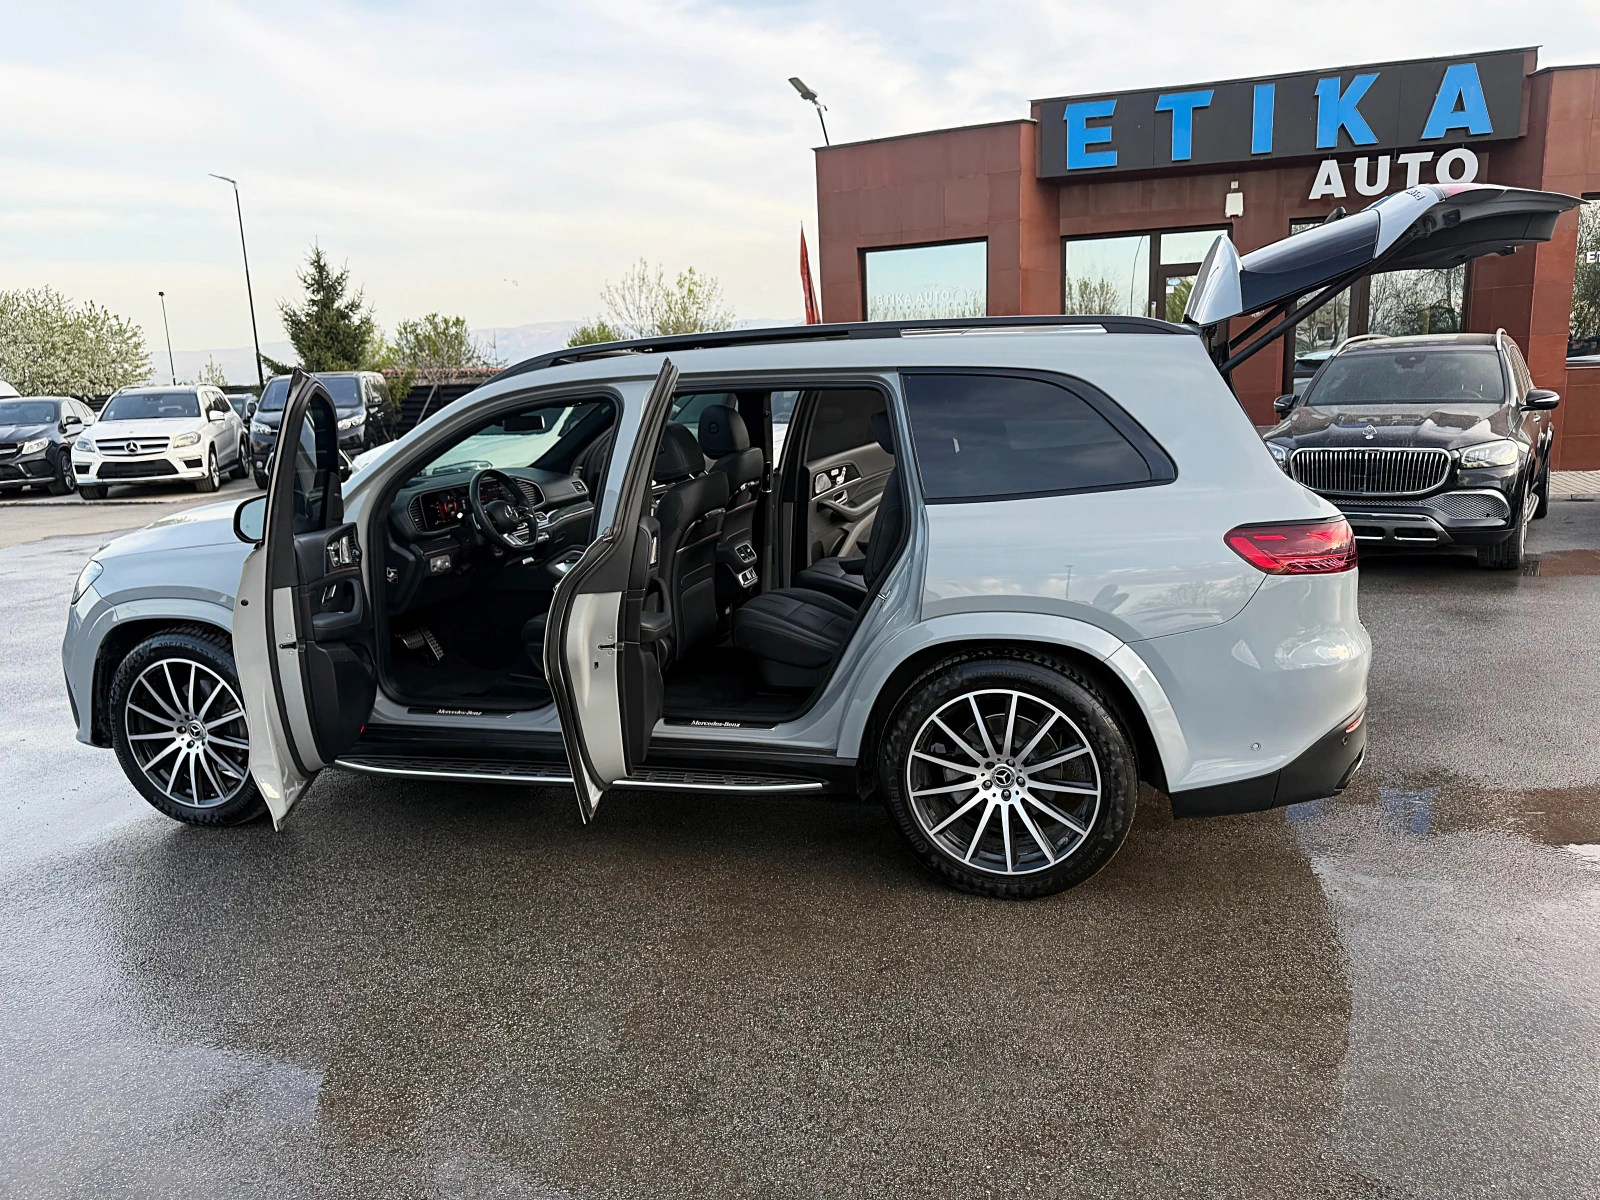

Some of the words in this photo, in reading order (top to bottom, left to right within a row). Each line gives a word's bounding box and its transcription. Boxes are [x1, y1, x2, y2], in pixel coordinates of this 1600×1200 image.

[1063, 62, 1494, 170] ETIKA
[1309, 148, 1478, 199] AUTO
[876, 292, 913, 306] ETIKA
[916, 290, 950, 304] AUTO
[690, 719, 741, 728] Mercedes-Benz
[887, 786, 929, 854] Continental
